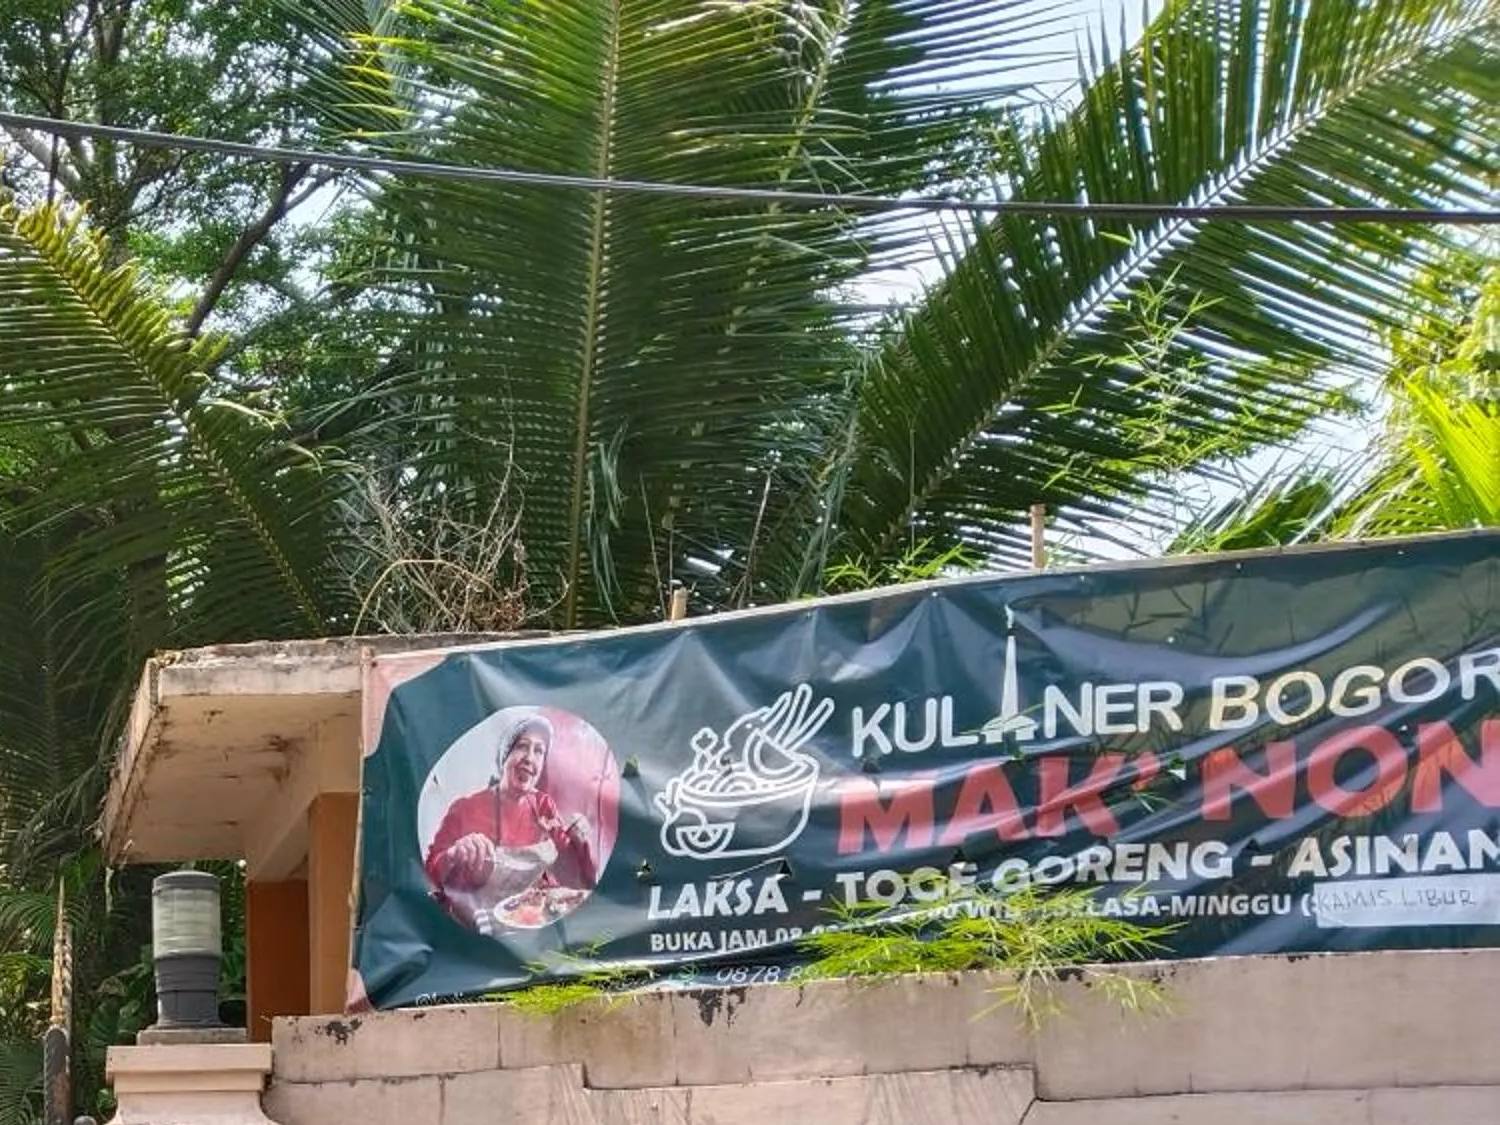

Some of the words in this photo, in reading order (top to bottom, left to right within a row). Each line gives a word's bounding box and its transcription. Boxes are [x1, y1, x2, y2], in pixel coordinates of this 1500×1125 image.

[1208, 648, 1500, 731] BOGOR
[1199, 719, 1500, 820] NON
[647, 873, 789, 919] LAKSA
[992, 841, 1233, 893] GORENG
[1287, 830, 1500, 878] ASINAN
[1402, 887, 1476, 908] LIBUR
[651, 930, 714, 952] BUKA
[719, 927, 767, 952] JAM
